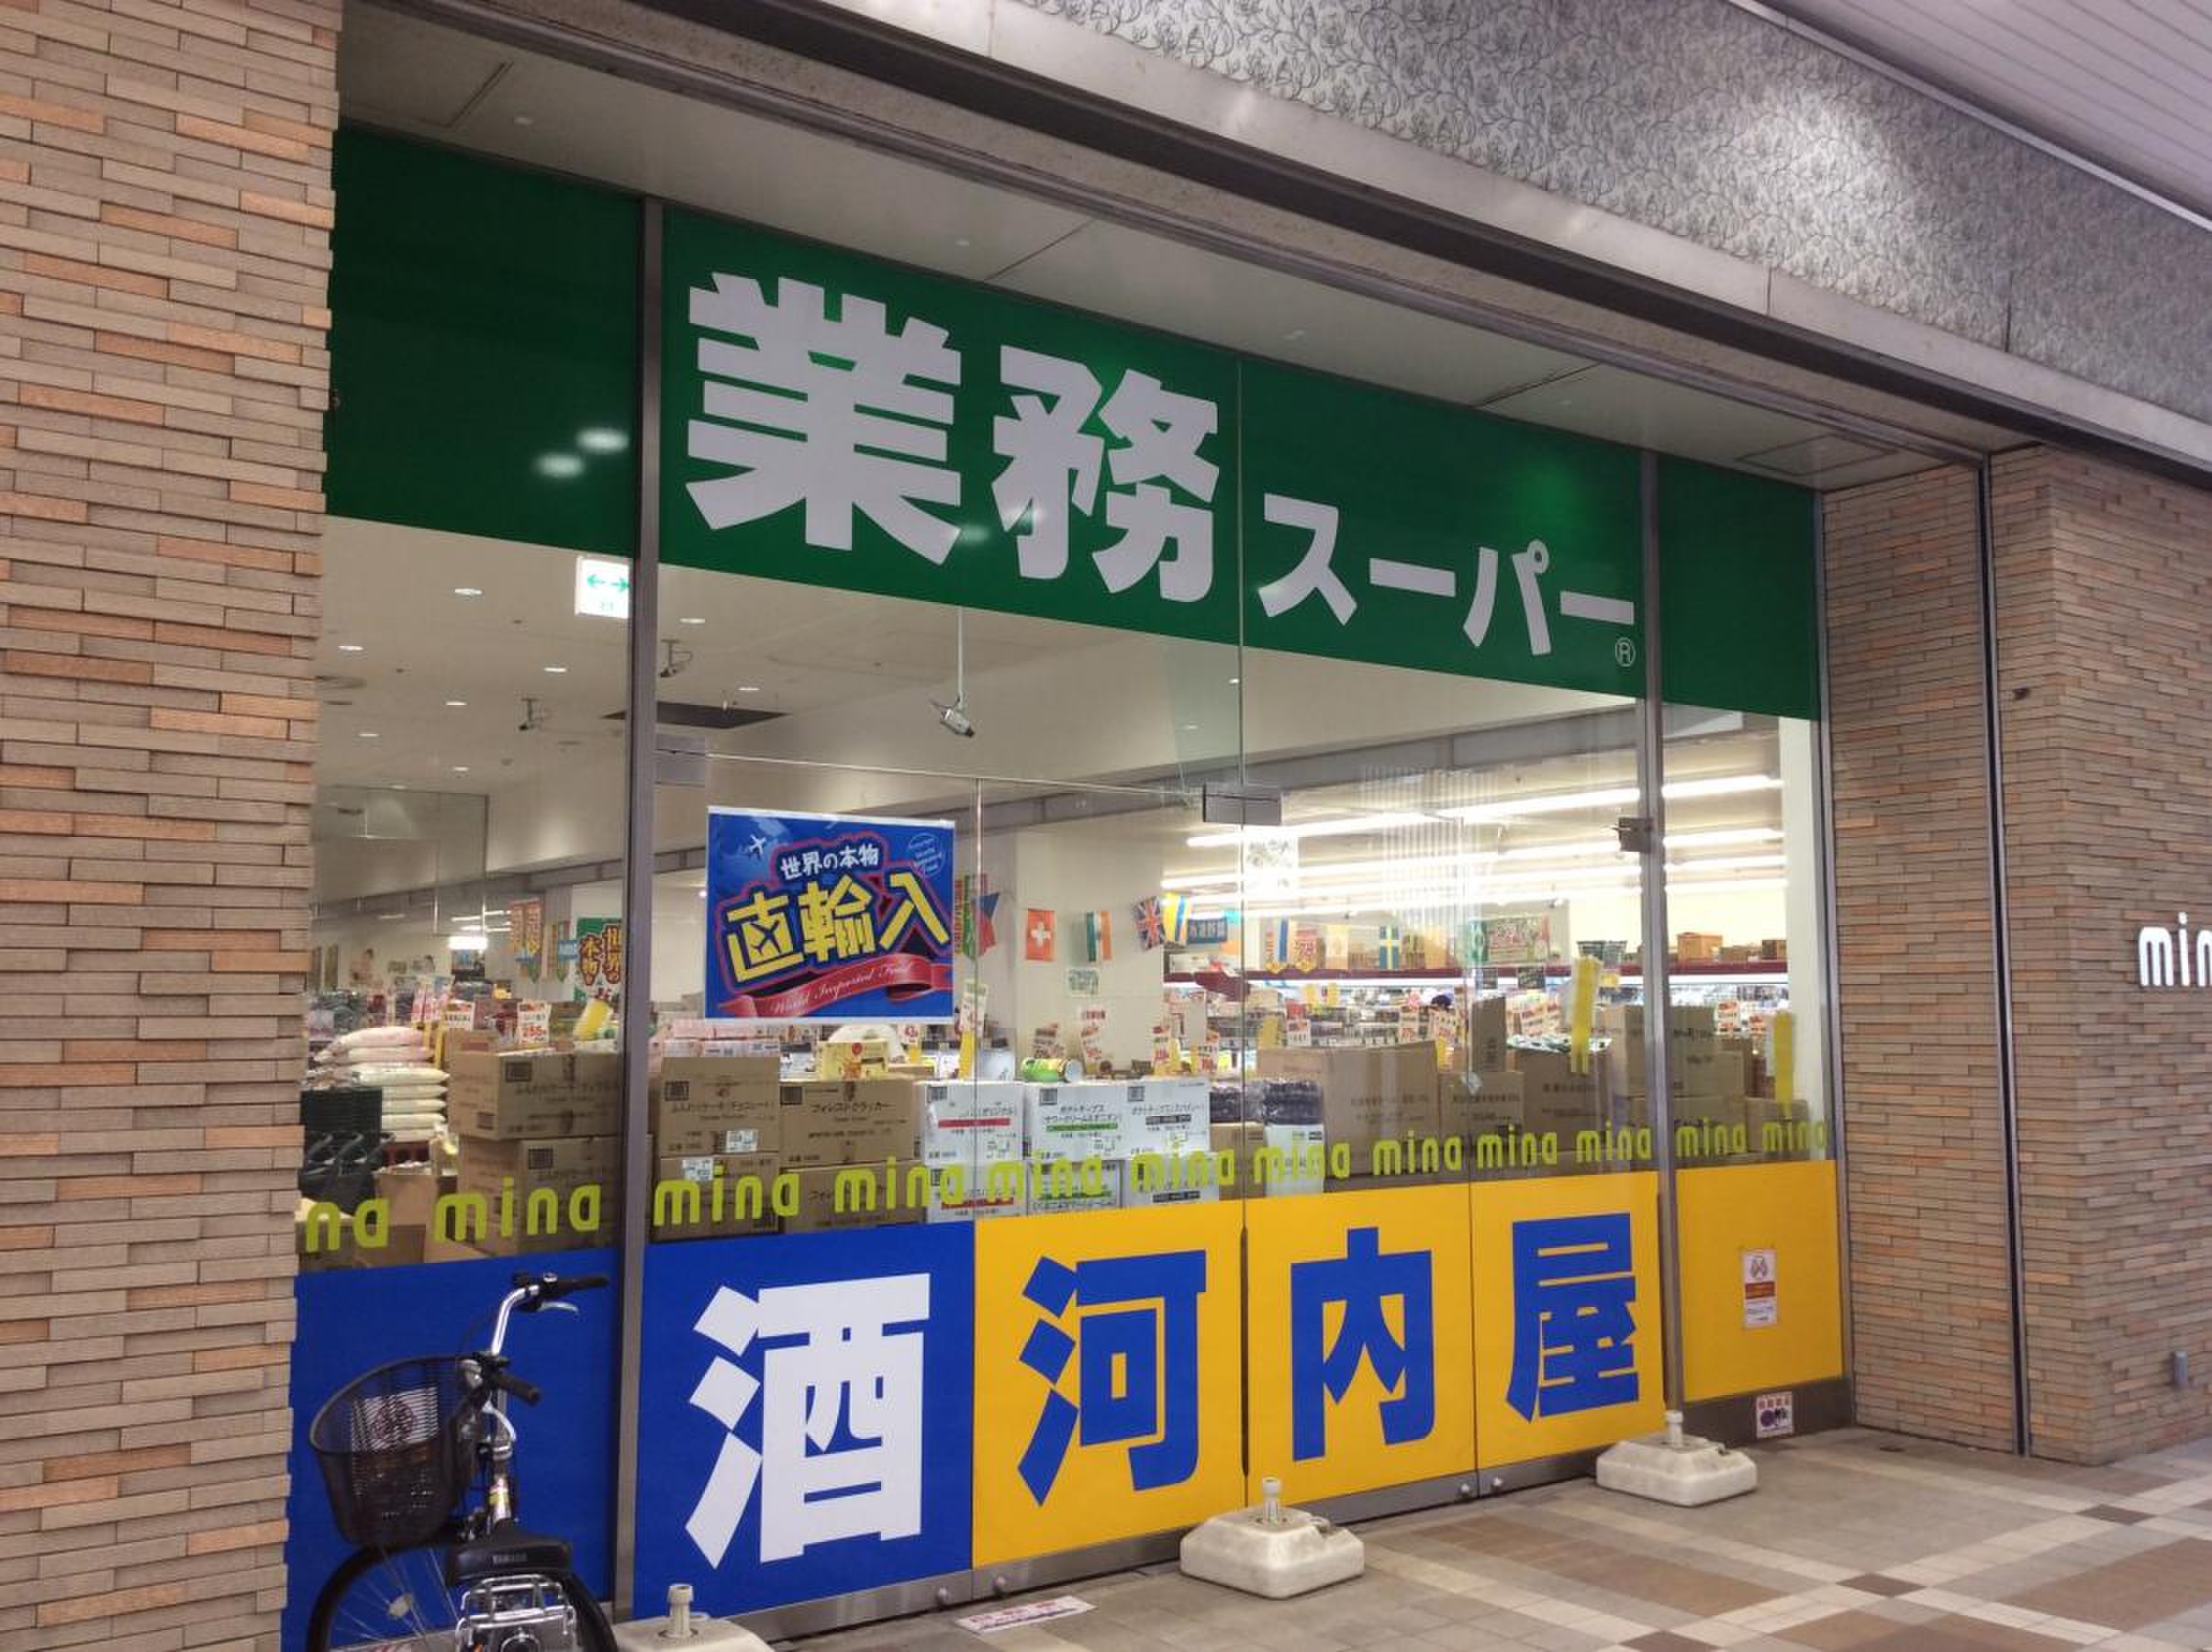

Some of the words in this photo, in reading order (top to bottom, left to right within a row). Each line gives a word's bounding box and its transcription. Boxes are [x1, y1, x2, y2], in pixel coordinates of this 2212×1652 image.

[686, 273, 1635, 658] 業務スーパー
[781, 843, 878, 879] 世界の本物
[727, 872, 949, 981] 直輸入
[432, 1176, 601, 1240] mina
[653, 1162, 800, 1226] mina
[833, 1155, 965, 1213] mina
[988, 1149, 1103, 1201] mina
[1130, 1136, 1235, 1190] mina
[1254, 1135, 1351, 1184] mina
[1371, 1130, 1463, 1176] mina
[1475, 1124, 1558, 1169] mina
[1575, 1118, 1652, 1163] mina
[1675, 1115, 1748, 1157] mina
[686, 1273, 931, 1568] 酒
[1018, 1212, 1639, 1508] 河内屋
